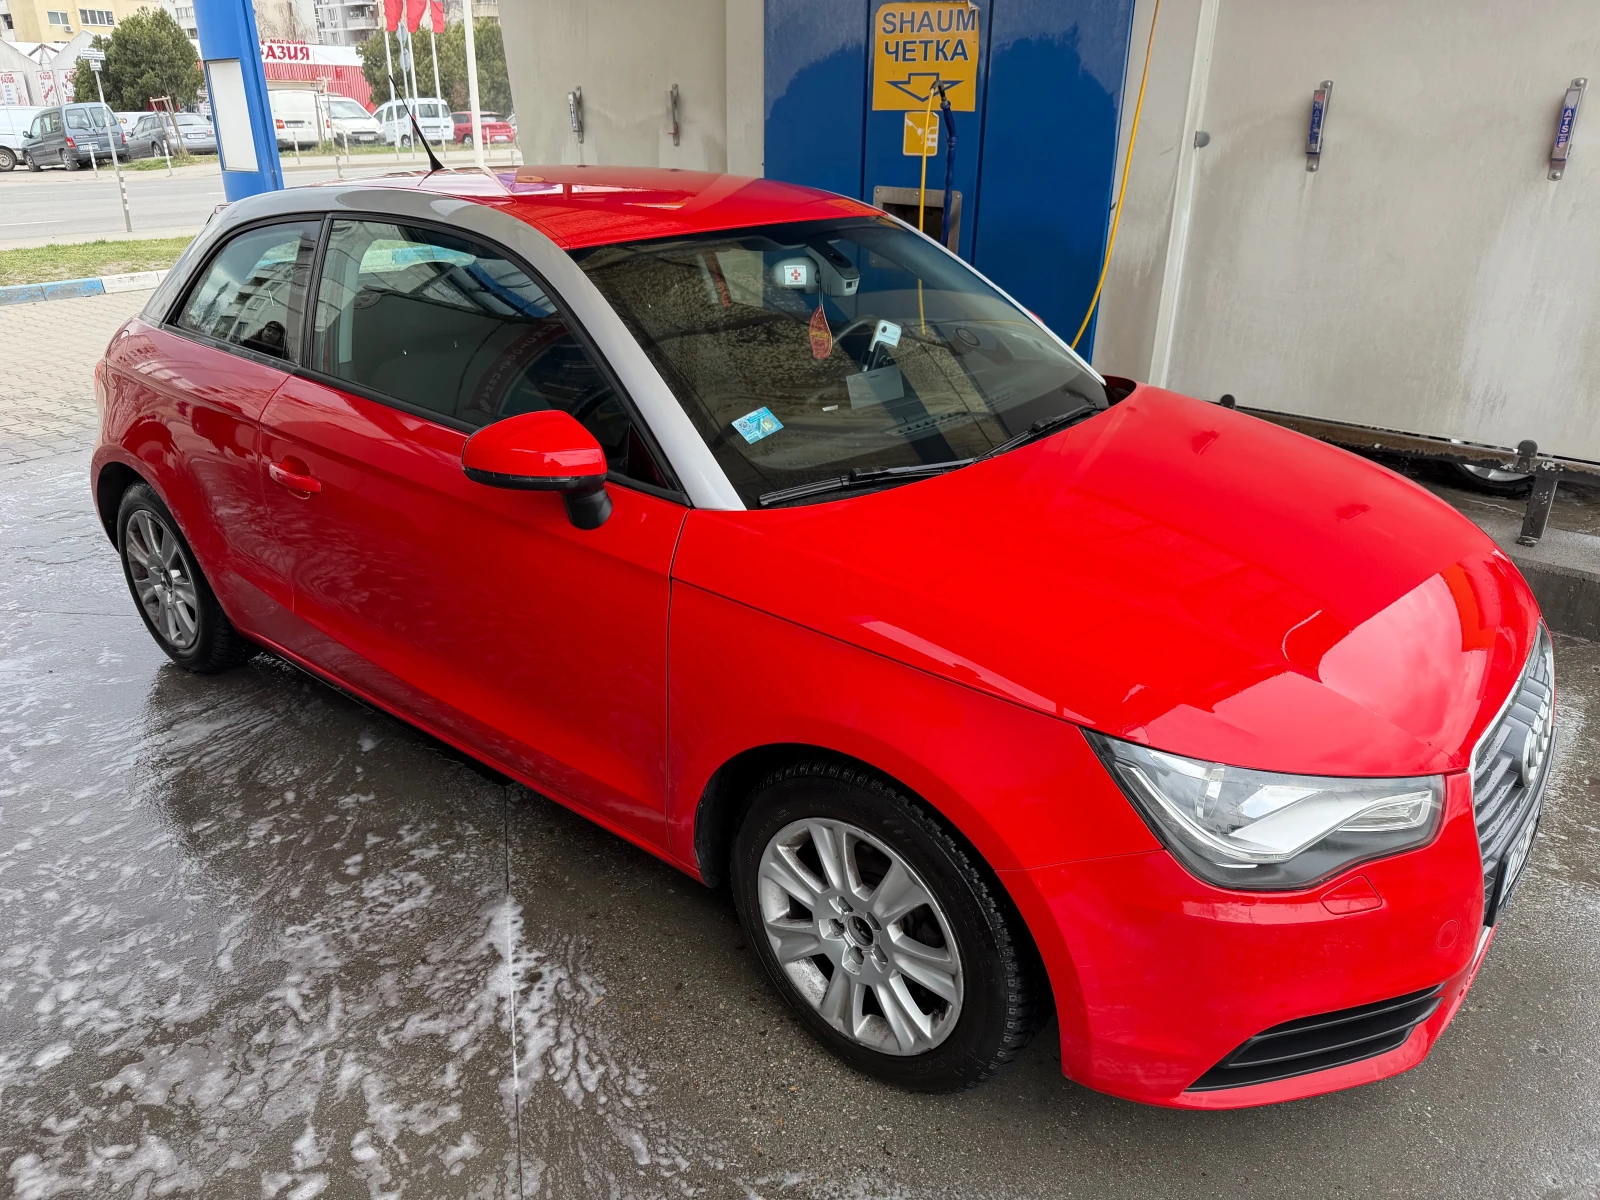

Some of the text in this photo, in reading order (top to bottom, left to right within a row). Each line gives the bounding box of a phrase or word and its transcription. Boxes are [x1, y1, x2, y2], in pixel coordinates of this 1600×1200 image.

[882, 9, 976, 34] SHAUM
[265, 45, 310, 60] АЗИЯ
[884, 39, 969, 62] ЧЕТКА
